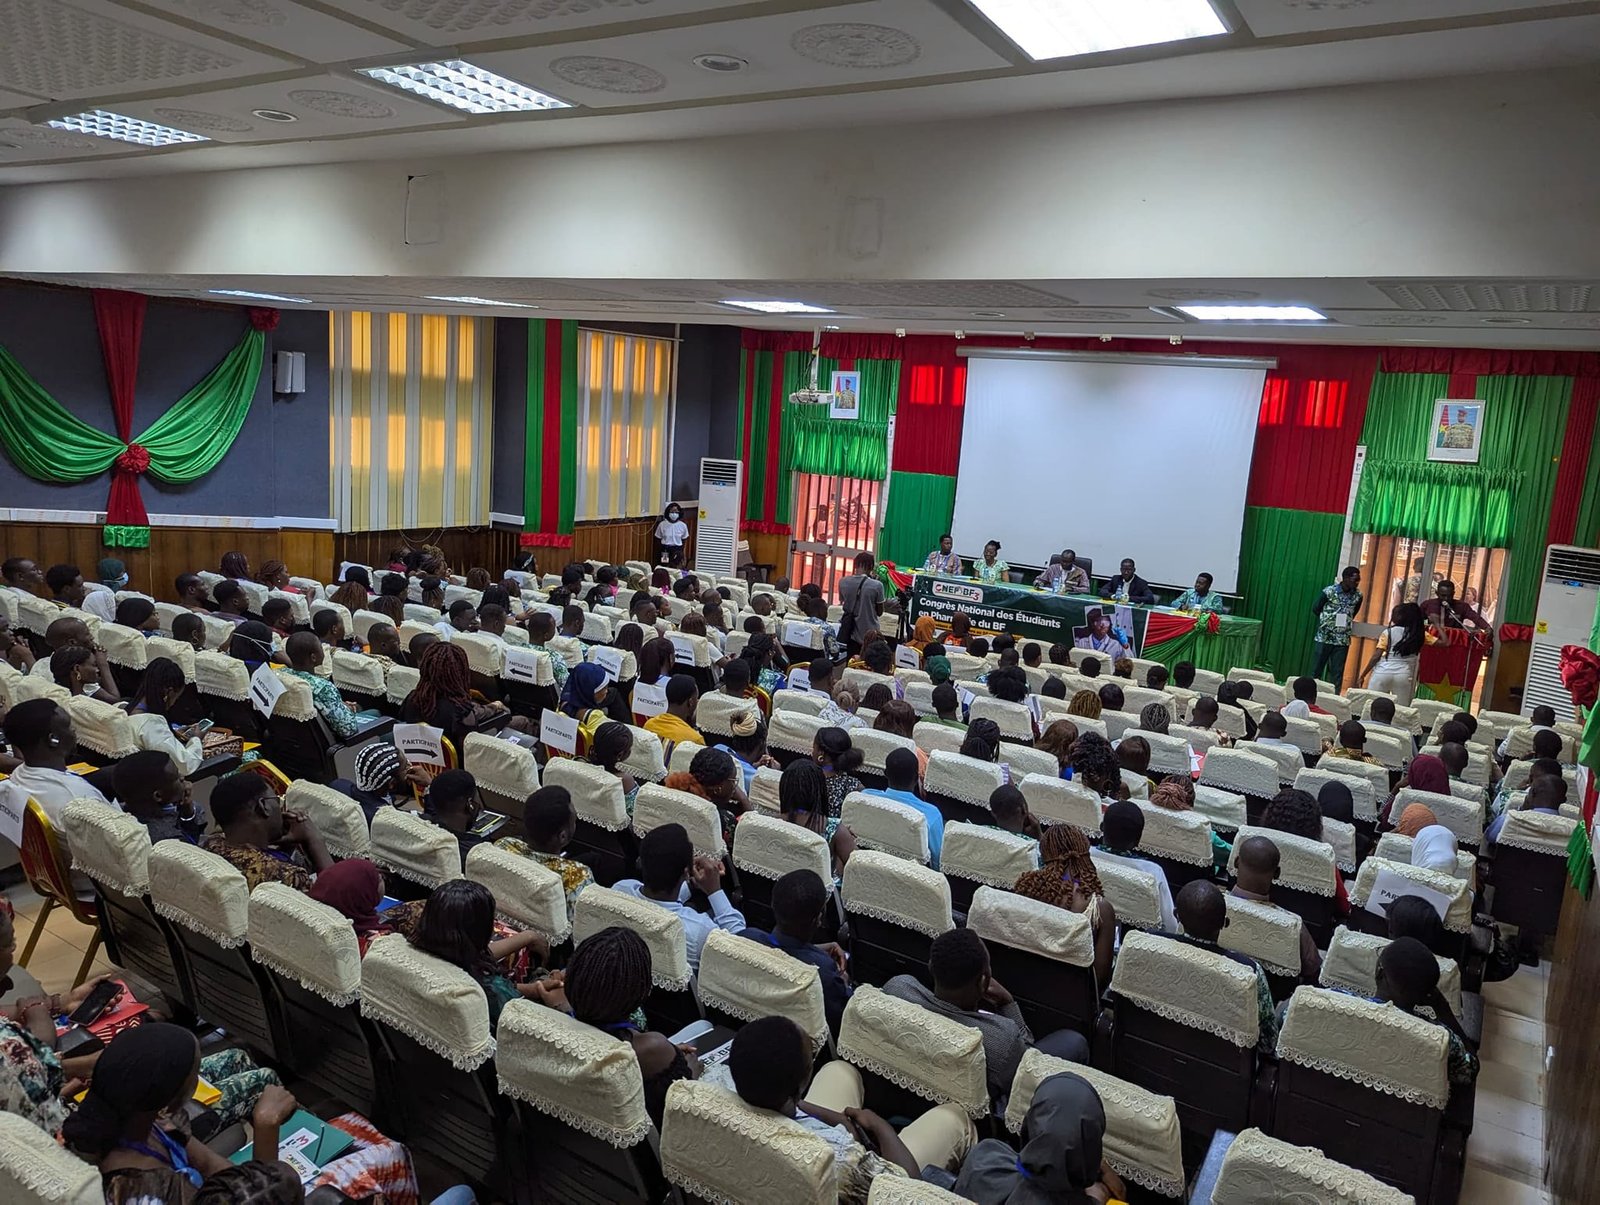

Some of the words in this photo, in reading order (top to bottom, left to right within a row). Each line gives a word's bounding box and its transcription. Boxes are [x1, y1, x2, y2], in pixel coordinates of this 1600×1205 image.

[920, 597, 956, 613] Congrès
[957, 602, 995, 617] National
[996, 608, 1014, 621] des
[1015, 609, 1062, 629] Étudiants
[978, 617, 991, 629] du
[993, 621, 1006, 631] BF
